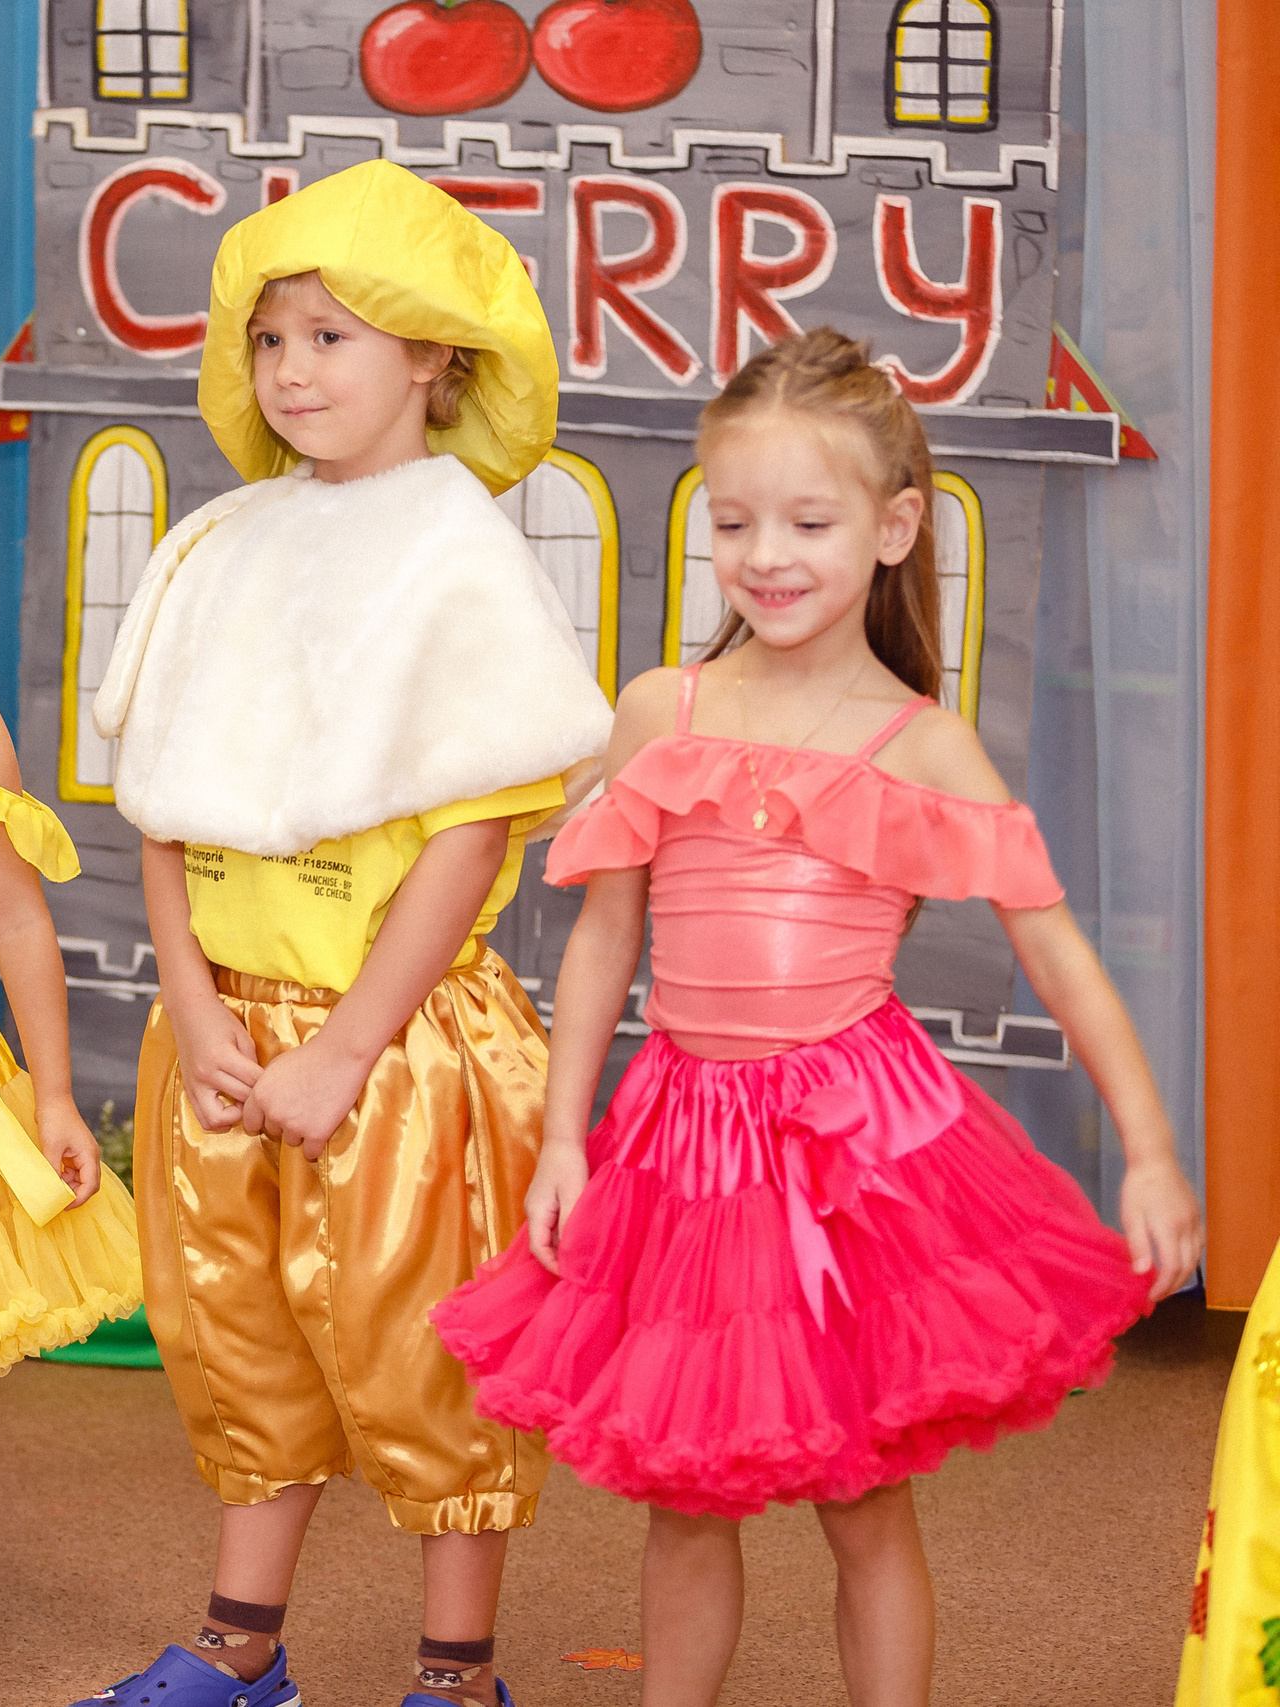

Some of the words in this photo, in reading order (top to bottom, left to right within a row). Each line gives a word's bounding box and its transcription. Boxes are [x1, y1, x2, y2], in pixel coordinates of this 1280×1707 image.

[79, 156, 1003, 407] CRRY
[298, 872, 338, 888] FRANCHISE
[314, 886, 325, 896] QC
